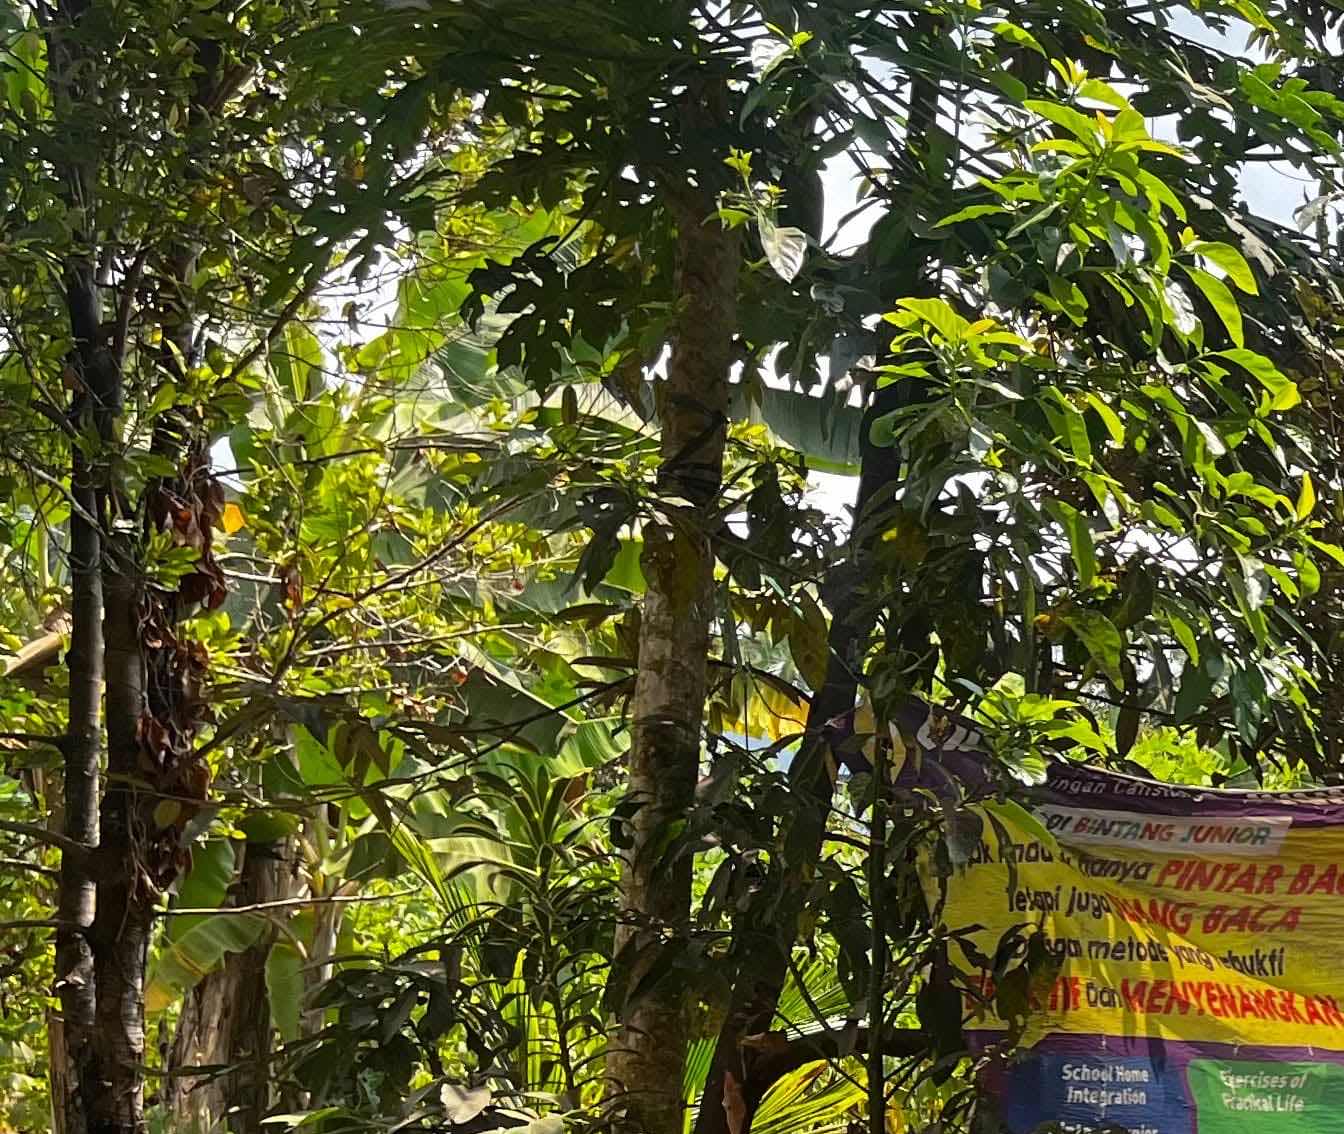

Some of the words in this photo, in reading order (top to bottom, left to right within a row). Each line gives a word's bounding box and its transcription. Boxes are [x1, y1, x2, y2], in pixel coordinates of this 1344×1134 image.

[1072, 815, 1178, 843] BINTANG
[1178, 824, 1271, 846] JUNIOR
[1154, 859, 1284, 895] PINTAR
[1200, 902, 1304, 934] BACA
[1061, 1063, 1113, 1083] School
[1114, 1065, 1149, 1083] Home
[1066, 1085, 1147, 1106] Integration
[1276, 1093, 1305, 1112] Life
